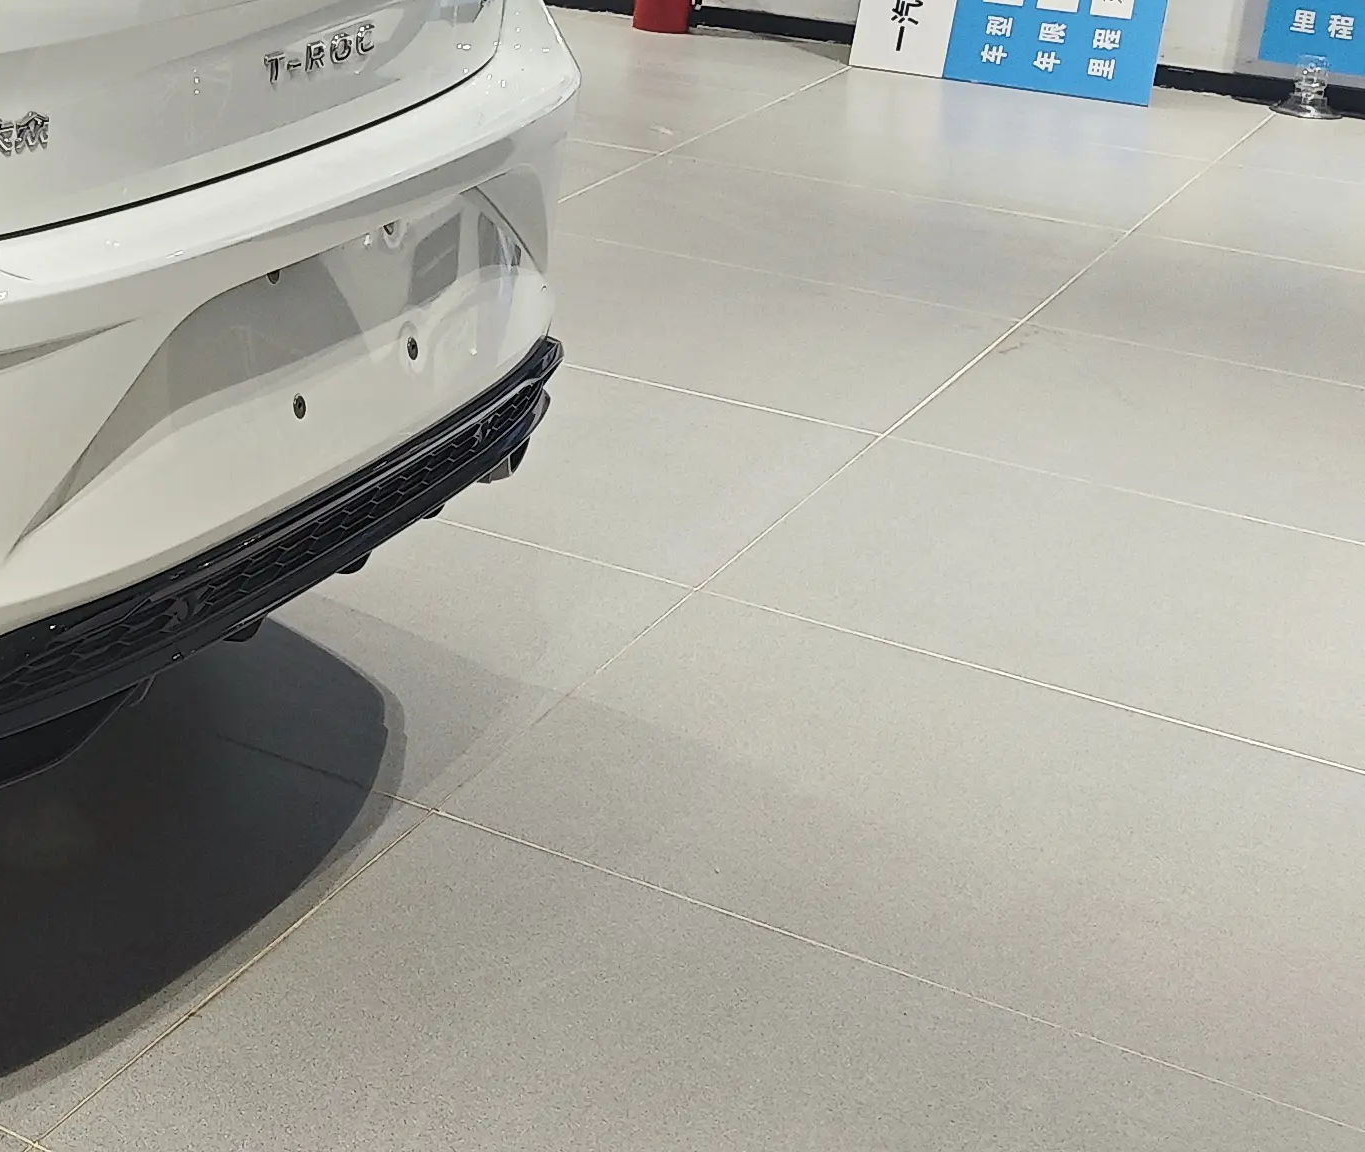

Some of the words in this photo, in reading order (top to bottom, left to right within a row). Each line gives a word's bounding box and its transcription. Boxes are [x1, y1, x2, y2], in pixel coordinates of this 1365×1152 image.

[981, 16, 1013, 64] 车型
[1034, 23, 1066, 71] 年限
[1289, 8, 1355, 41] 里程
[263, 22, 376, 84] T-ROC
[1088, 29, 1121, 79] 里程
